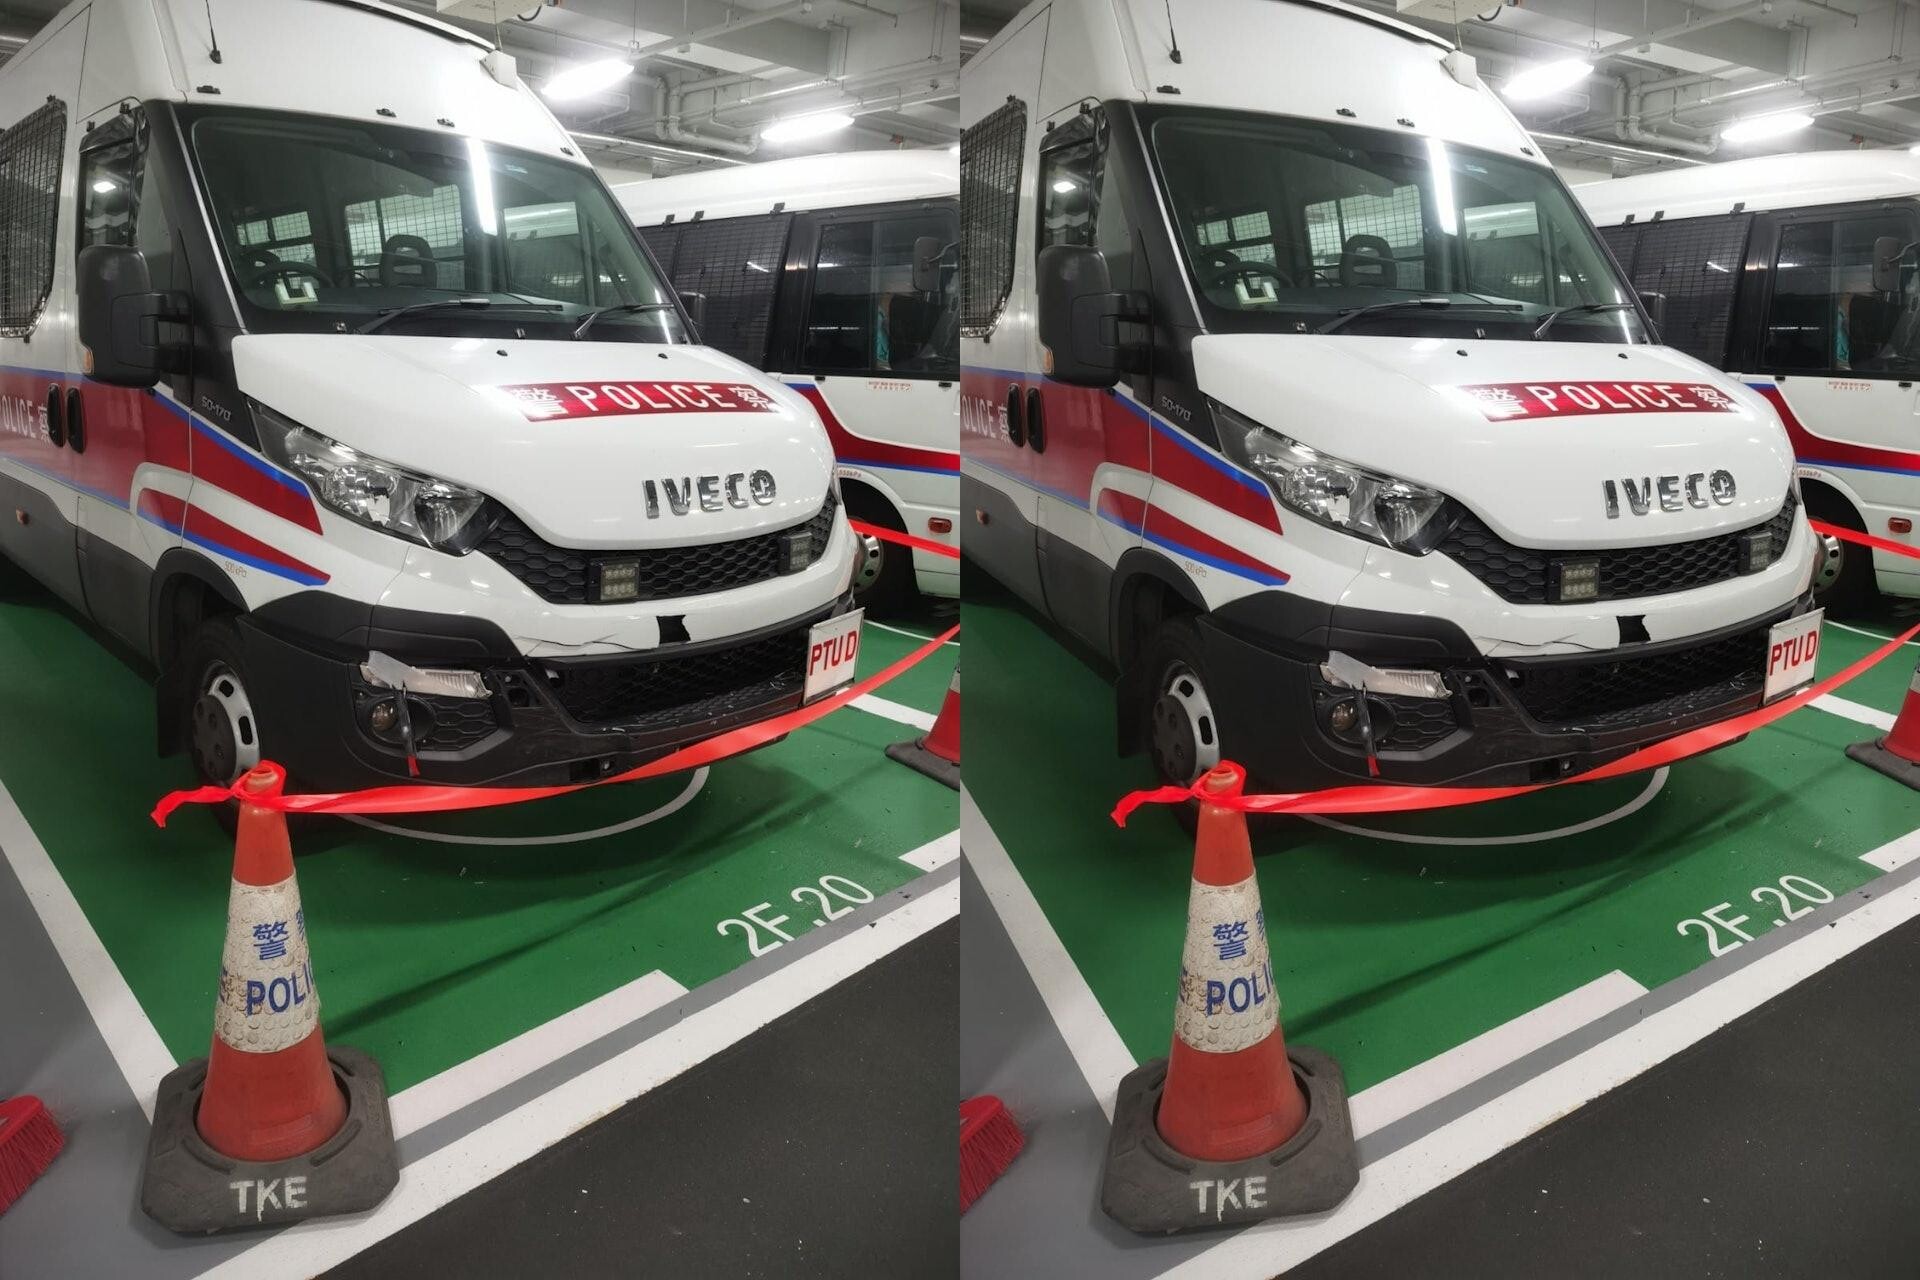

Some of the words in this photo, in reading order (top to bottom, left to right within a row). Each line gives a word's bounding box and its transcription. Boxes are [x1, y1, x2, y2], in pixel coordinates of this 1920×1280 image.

[0, 394, 37, 439] OLICE
[566, 384, 735, 411] POLICE
[960, 394, 997, 439] OLICE
[1526, 384, 1695, 411] POLICE
[642, 469, 777, 519] IVECO
[1602, 469, 1737, 519] IVECO
[246, 959, 314, 1017] POLI
[1206, 959, 1274, 1017] POLI
[229, 1176, 308, 1222] TKE
[1189, 1176, 1268, 1222] TKE
